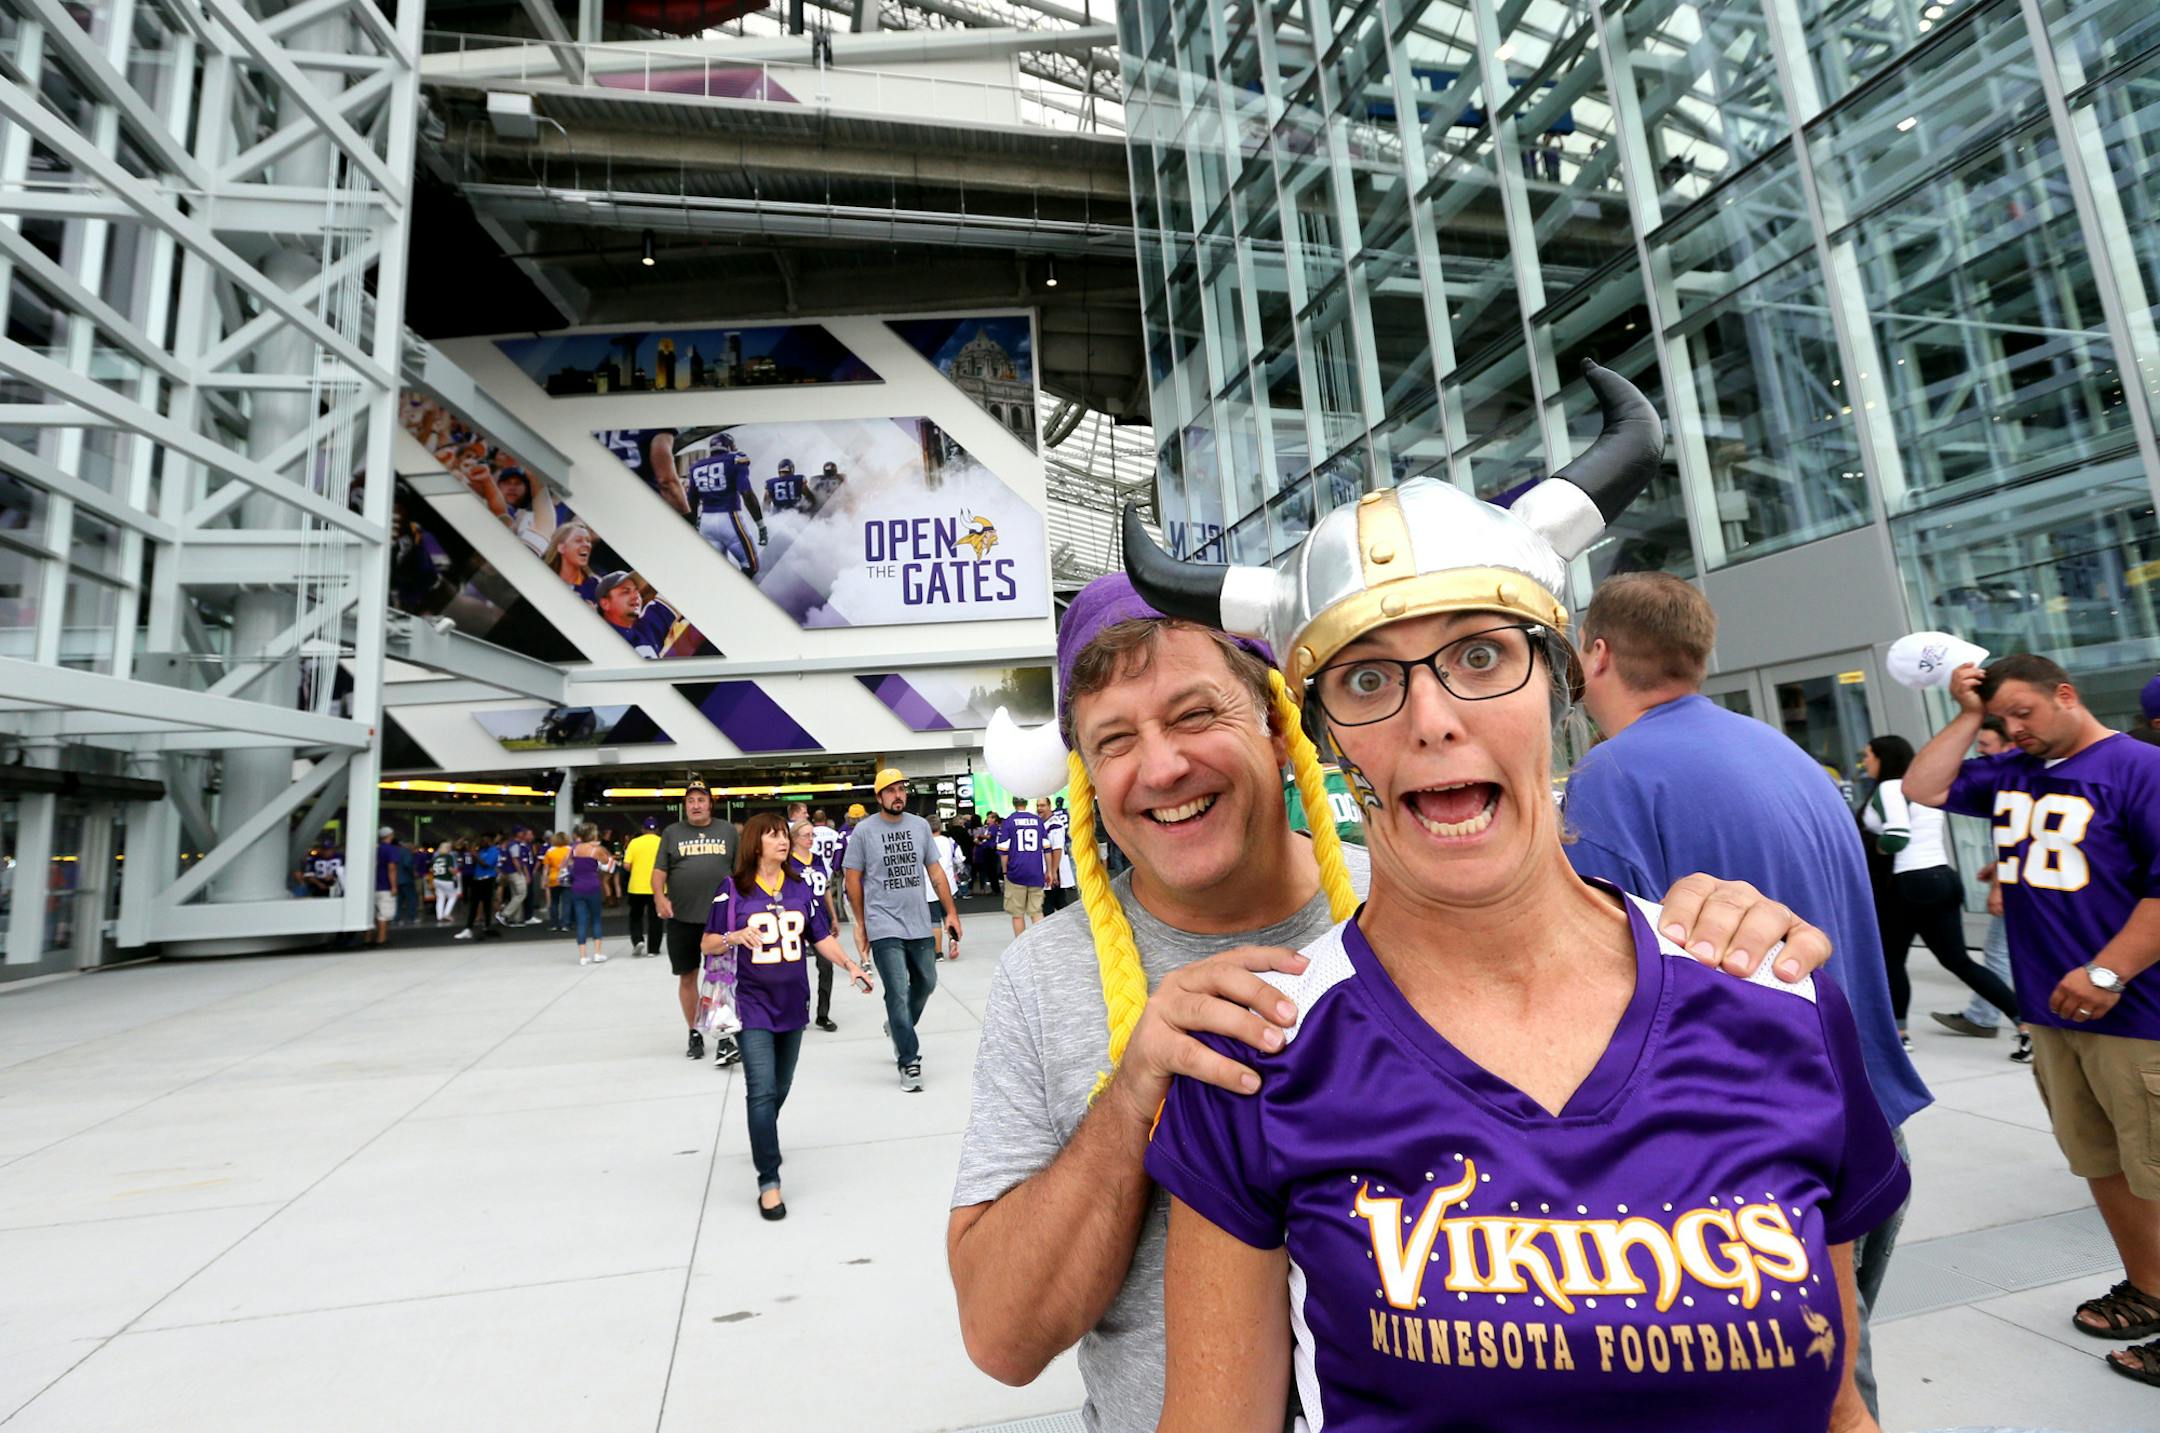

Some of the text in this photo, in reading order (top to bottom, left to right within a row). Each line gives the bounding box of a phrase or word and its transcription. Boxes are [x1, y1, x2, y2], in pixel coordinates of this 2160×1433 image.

[692, 462, 727, 492] 68
[774, 481, 796, 502] 61
[865, 517, 958, 562] OPEN
[866, 558, 1017, 605] THE GATES
[881, 830, 912, 843] I HAVE
[884, 841, 914, 854] MIXED
[1016, 828, 1038, 852] 19
[1991, 790, 2095, 892] 28
[678, 843, 726, 857] VIKINGS
[883, 852, 917, 866] DRINKS
[888, 864, 916, 878] ABOUT
[883, 876, 920, 890] FEELINGS
[747, 910, 805, 964] 28
[1369, 1308, 1796, 1373] MINNESOTA FOOTBALL
